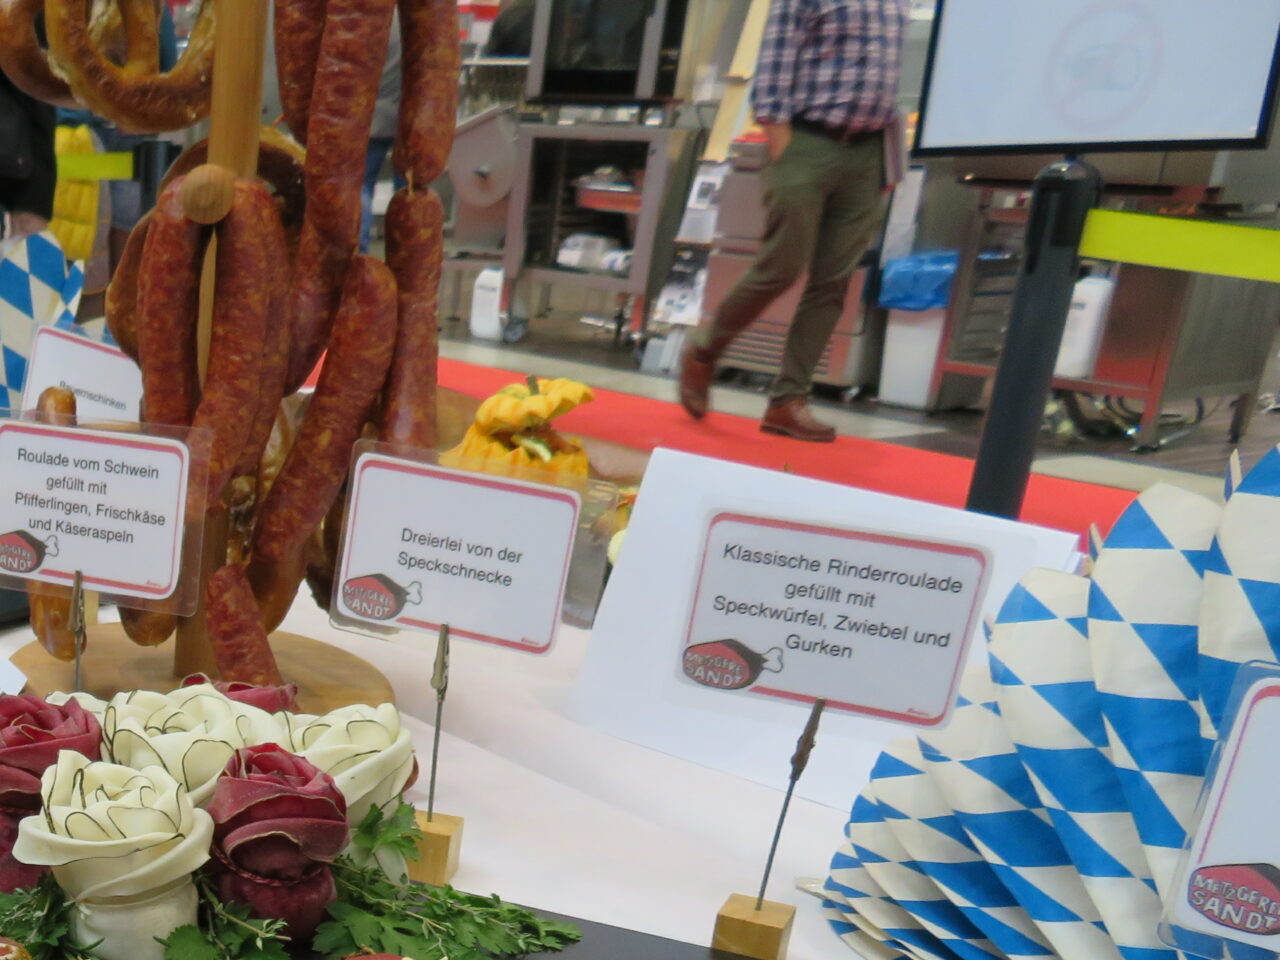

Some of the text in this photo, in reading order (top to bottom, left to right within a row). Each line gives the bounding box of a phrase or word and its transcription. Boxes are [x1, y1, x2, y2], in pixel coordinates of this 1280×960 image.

[18, 448, 159, 479] Roulade vom Schwein
[46, 476, 107, 494] gefüllt mit
[15, 492, 166, 525] Pfifferlingen, Frischkäse
[29, 519, 134, 544] und Käseraspeln
[401, 528, 522, 563] Dreierlei von der
[398, 552, 512, 586] Speckschnecke
[723, 544, 963, 594] Klassische Rinderroulade
[784, 583, 875, 608] gefüllt mit
[713, 595, 950, 648] Speckwürfel, Zwiebel und
[785, 634, 852, 658] Gurken
[1192, 891, 1278, 930] SANDT
